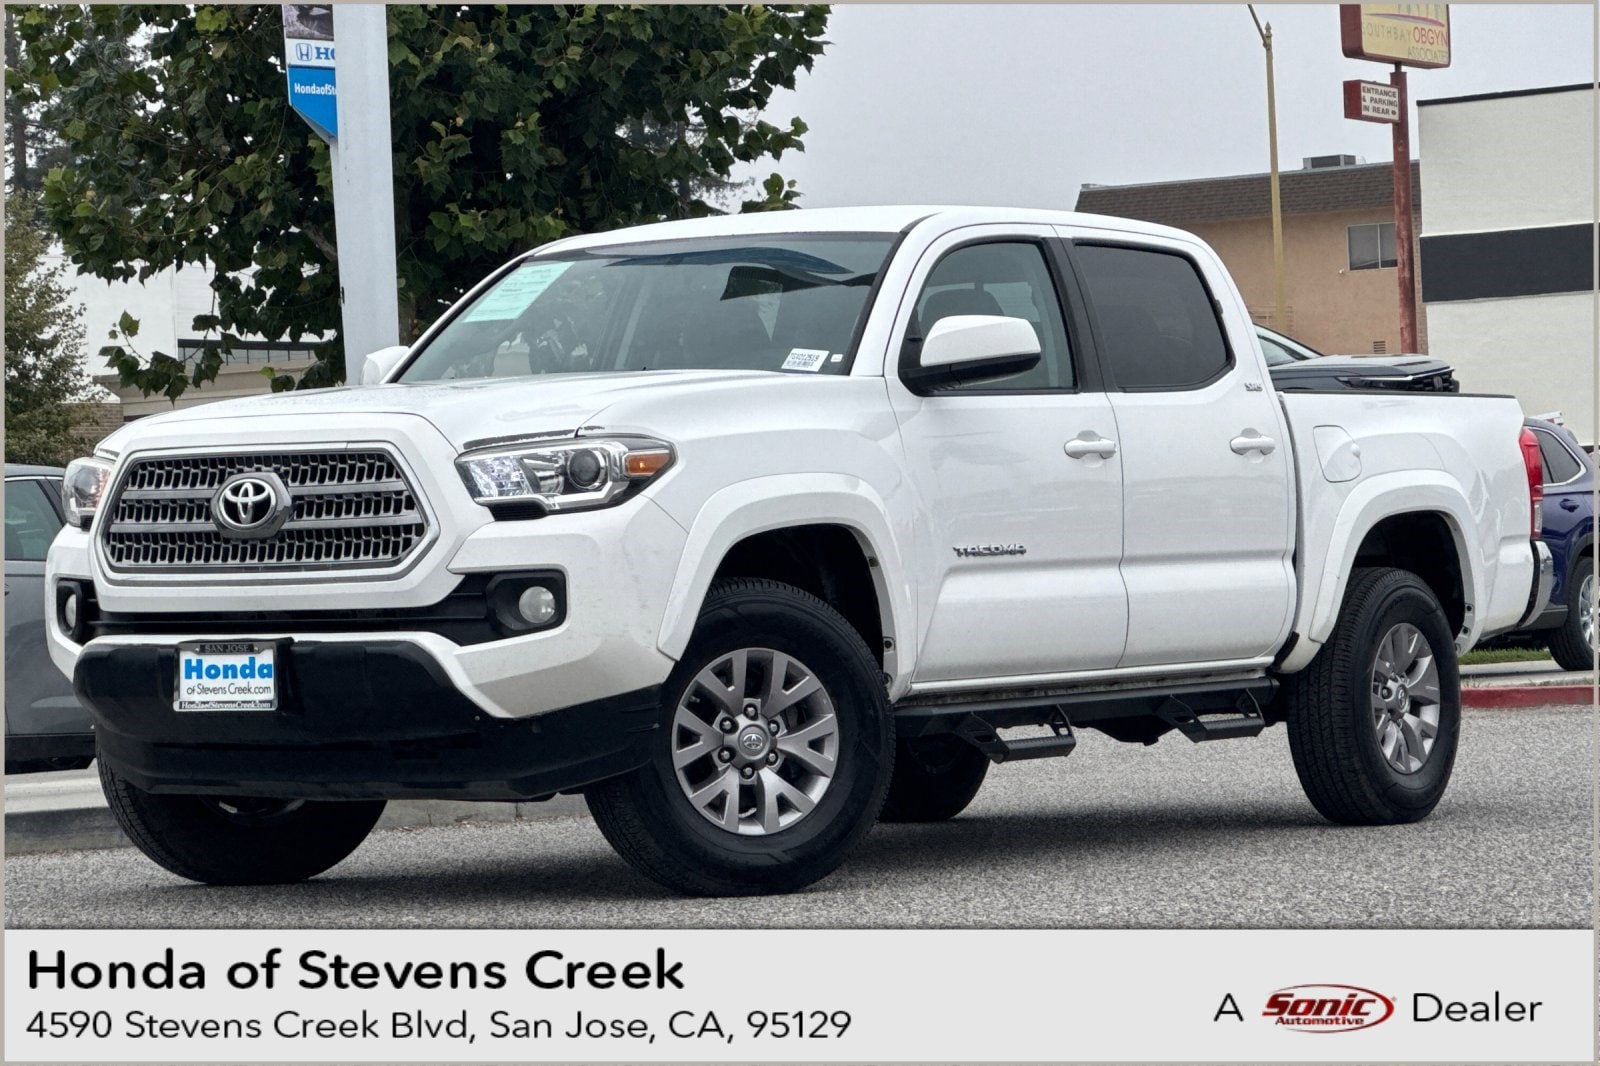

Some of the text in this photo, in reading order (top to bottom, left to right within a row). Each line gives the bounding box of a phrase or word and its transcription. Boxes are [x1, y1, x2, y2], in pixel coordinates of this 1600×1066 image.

[1413, 26, 1448, 47] OBGYN
[1408, 46, 1448, 61] ASSOCIATE
[1362, 86, 1397, 99] ENTRANCE
[1362, 104, 1390, 115] IN REAR
[1370, 97, 1398, 108] PARKING
[953, 543, 1027, 557] TACOMA
[205, 644, 250, 653] SAN JOSE
[184, 656, 273, 680] Honda
[186, 681, 272, 695] of Stevens Creek.com
